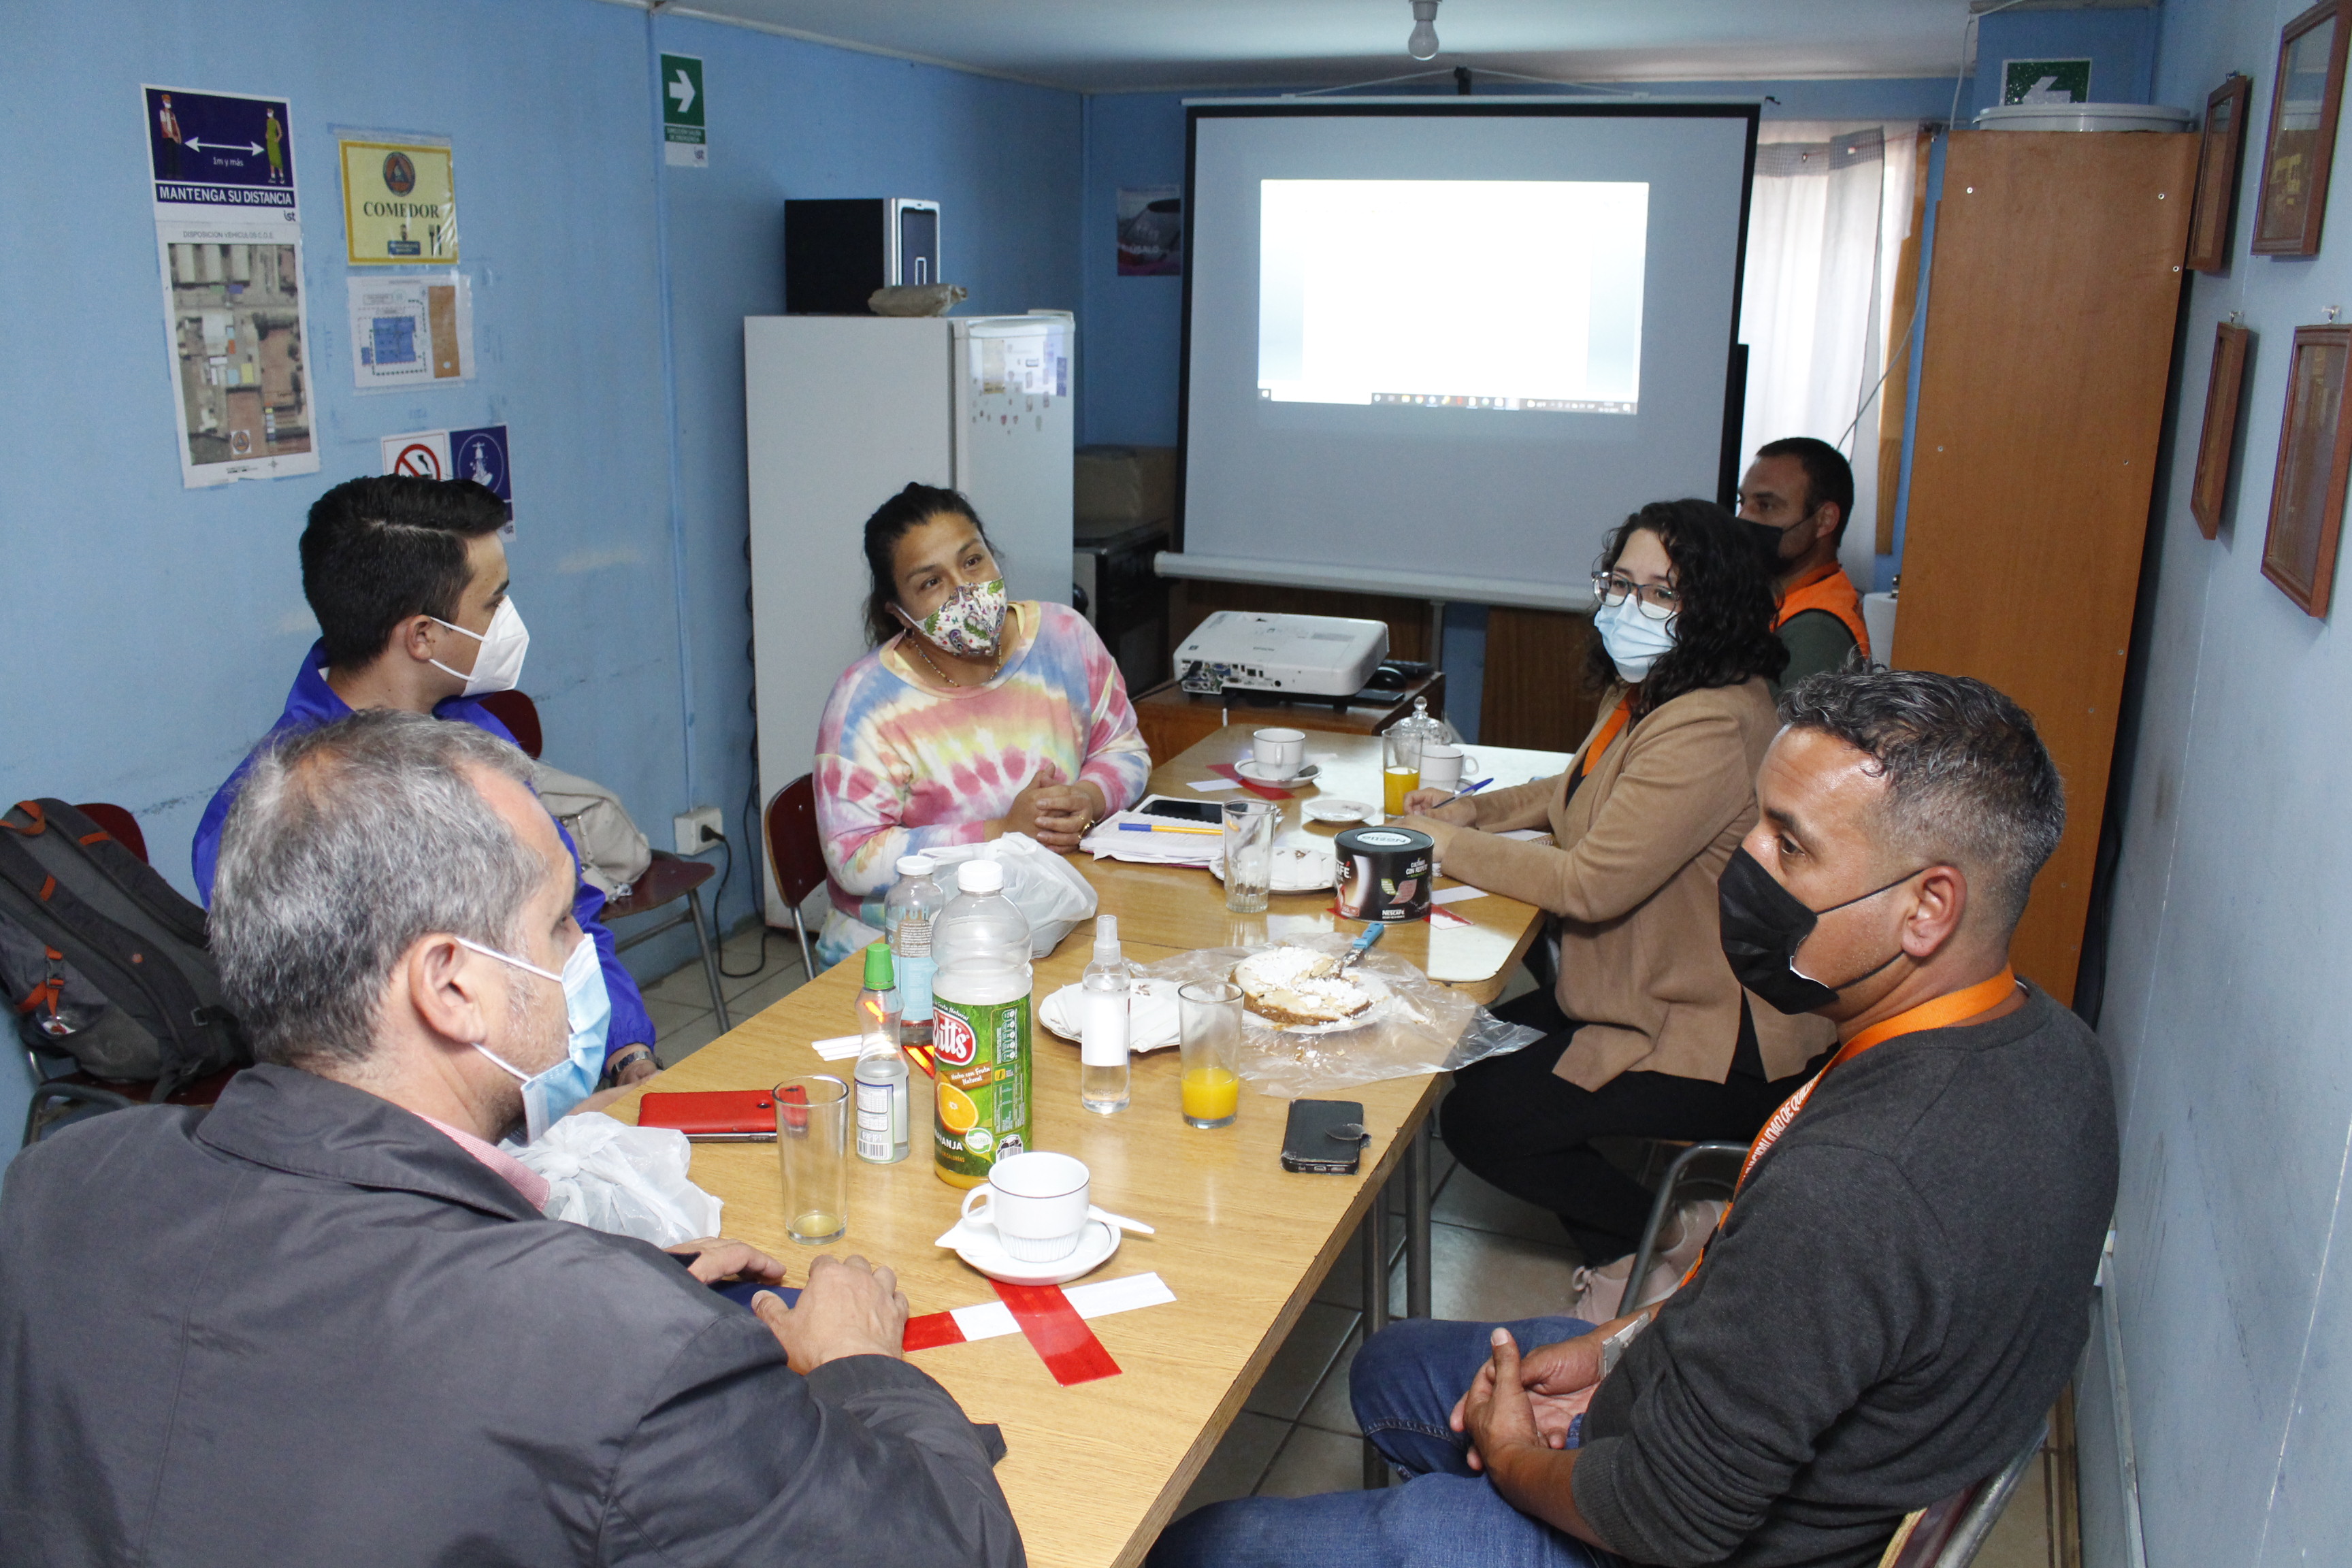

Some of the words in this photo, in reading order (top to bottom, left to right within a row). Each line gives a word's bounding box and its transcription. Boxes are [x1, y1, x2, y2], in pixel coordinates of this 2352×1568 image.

[212, 157, 224, 165] 1m
[225, 159, 229, 167] y
[230, 157, 244, 167] más
[159, 186, 227, 202] MANTENGA
[228, 190, 242, 203] SU
[244, 191, 292, 205] DISTANCIA
[363, 201, 440, 218] COMEDOR
[283, 210, 296, 222] ist
[1382, 908, 1405, 916] NESCAFÉ
[949, 1007, 970, 1021] Natural
[975, 1066, 991, 1075] Fruta
[962, 1075, 983, 1086] Natural
[1780, 1101, 1795, 1124] DE
